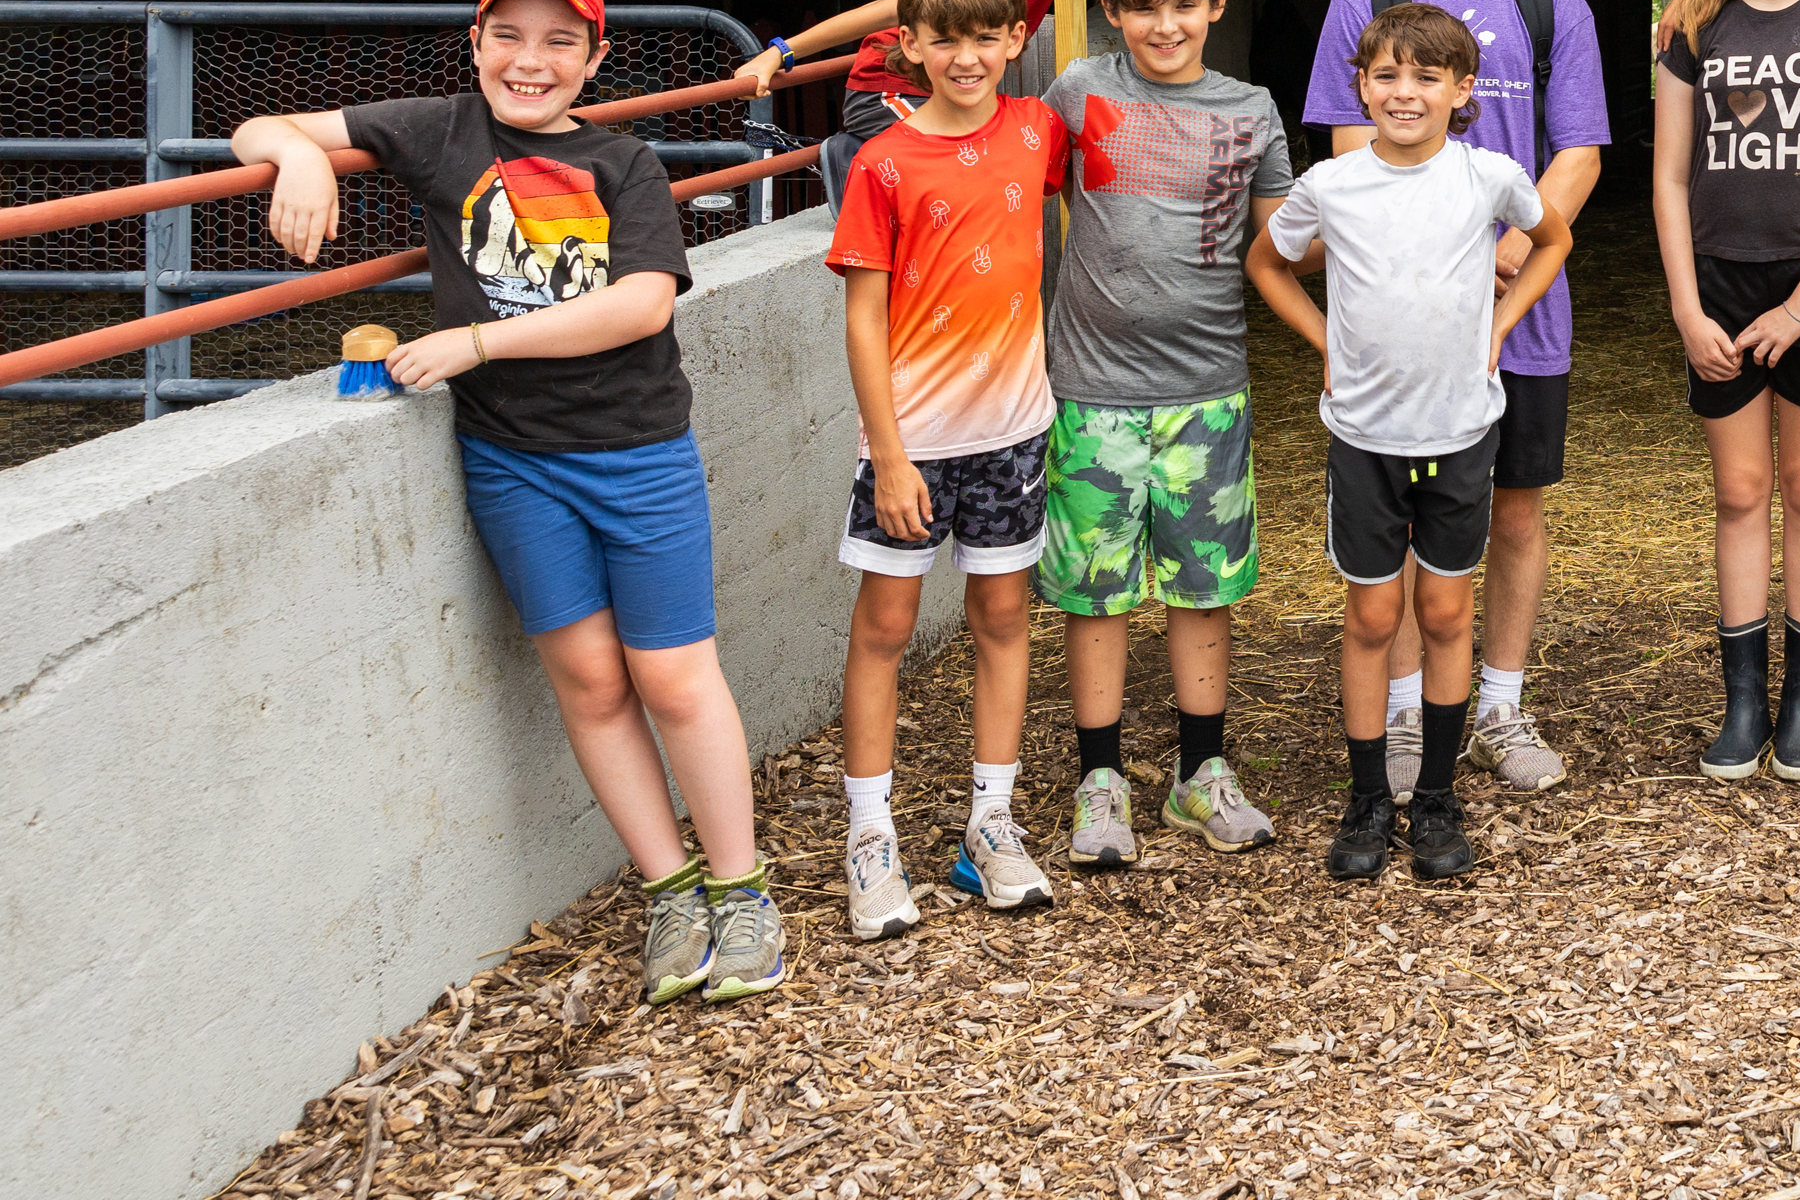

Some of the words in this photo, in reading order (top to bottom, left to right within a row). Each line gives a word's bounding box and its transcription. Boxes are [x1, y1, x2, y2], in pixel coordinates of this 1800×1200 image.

[1477, 90, 1501, 98] DOVER,
[1199, 112, 1230, 269] ARMOUR
[1217, 116, 1254, 232] UNDER
[489, 299, 528, 319] Virginia
